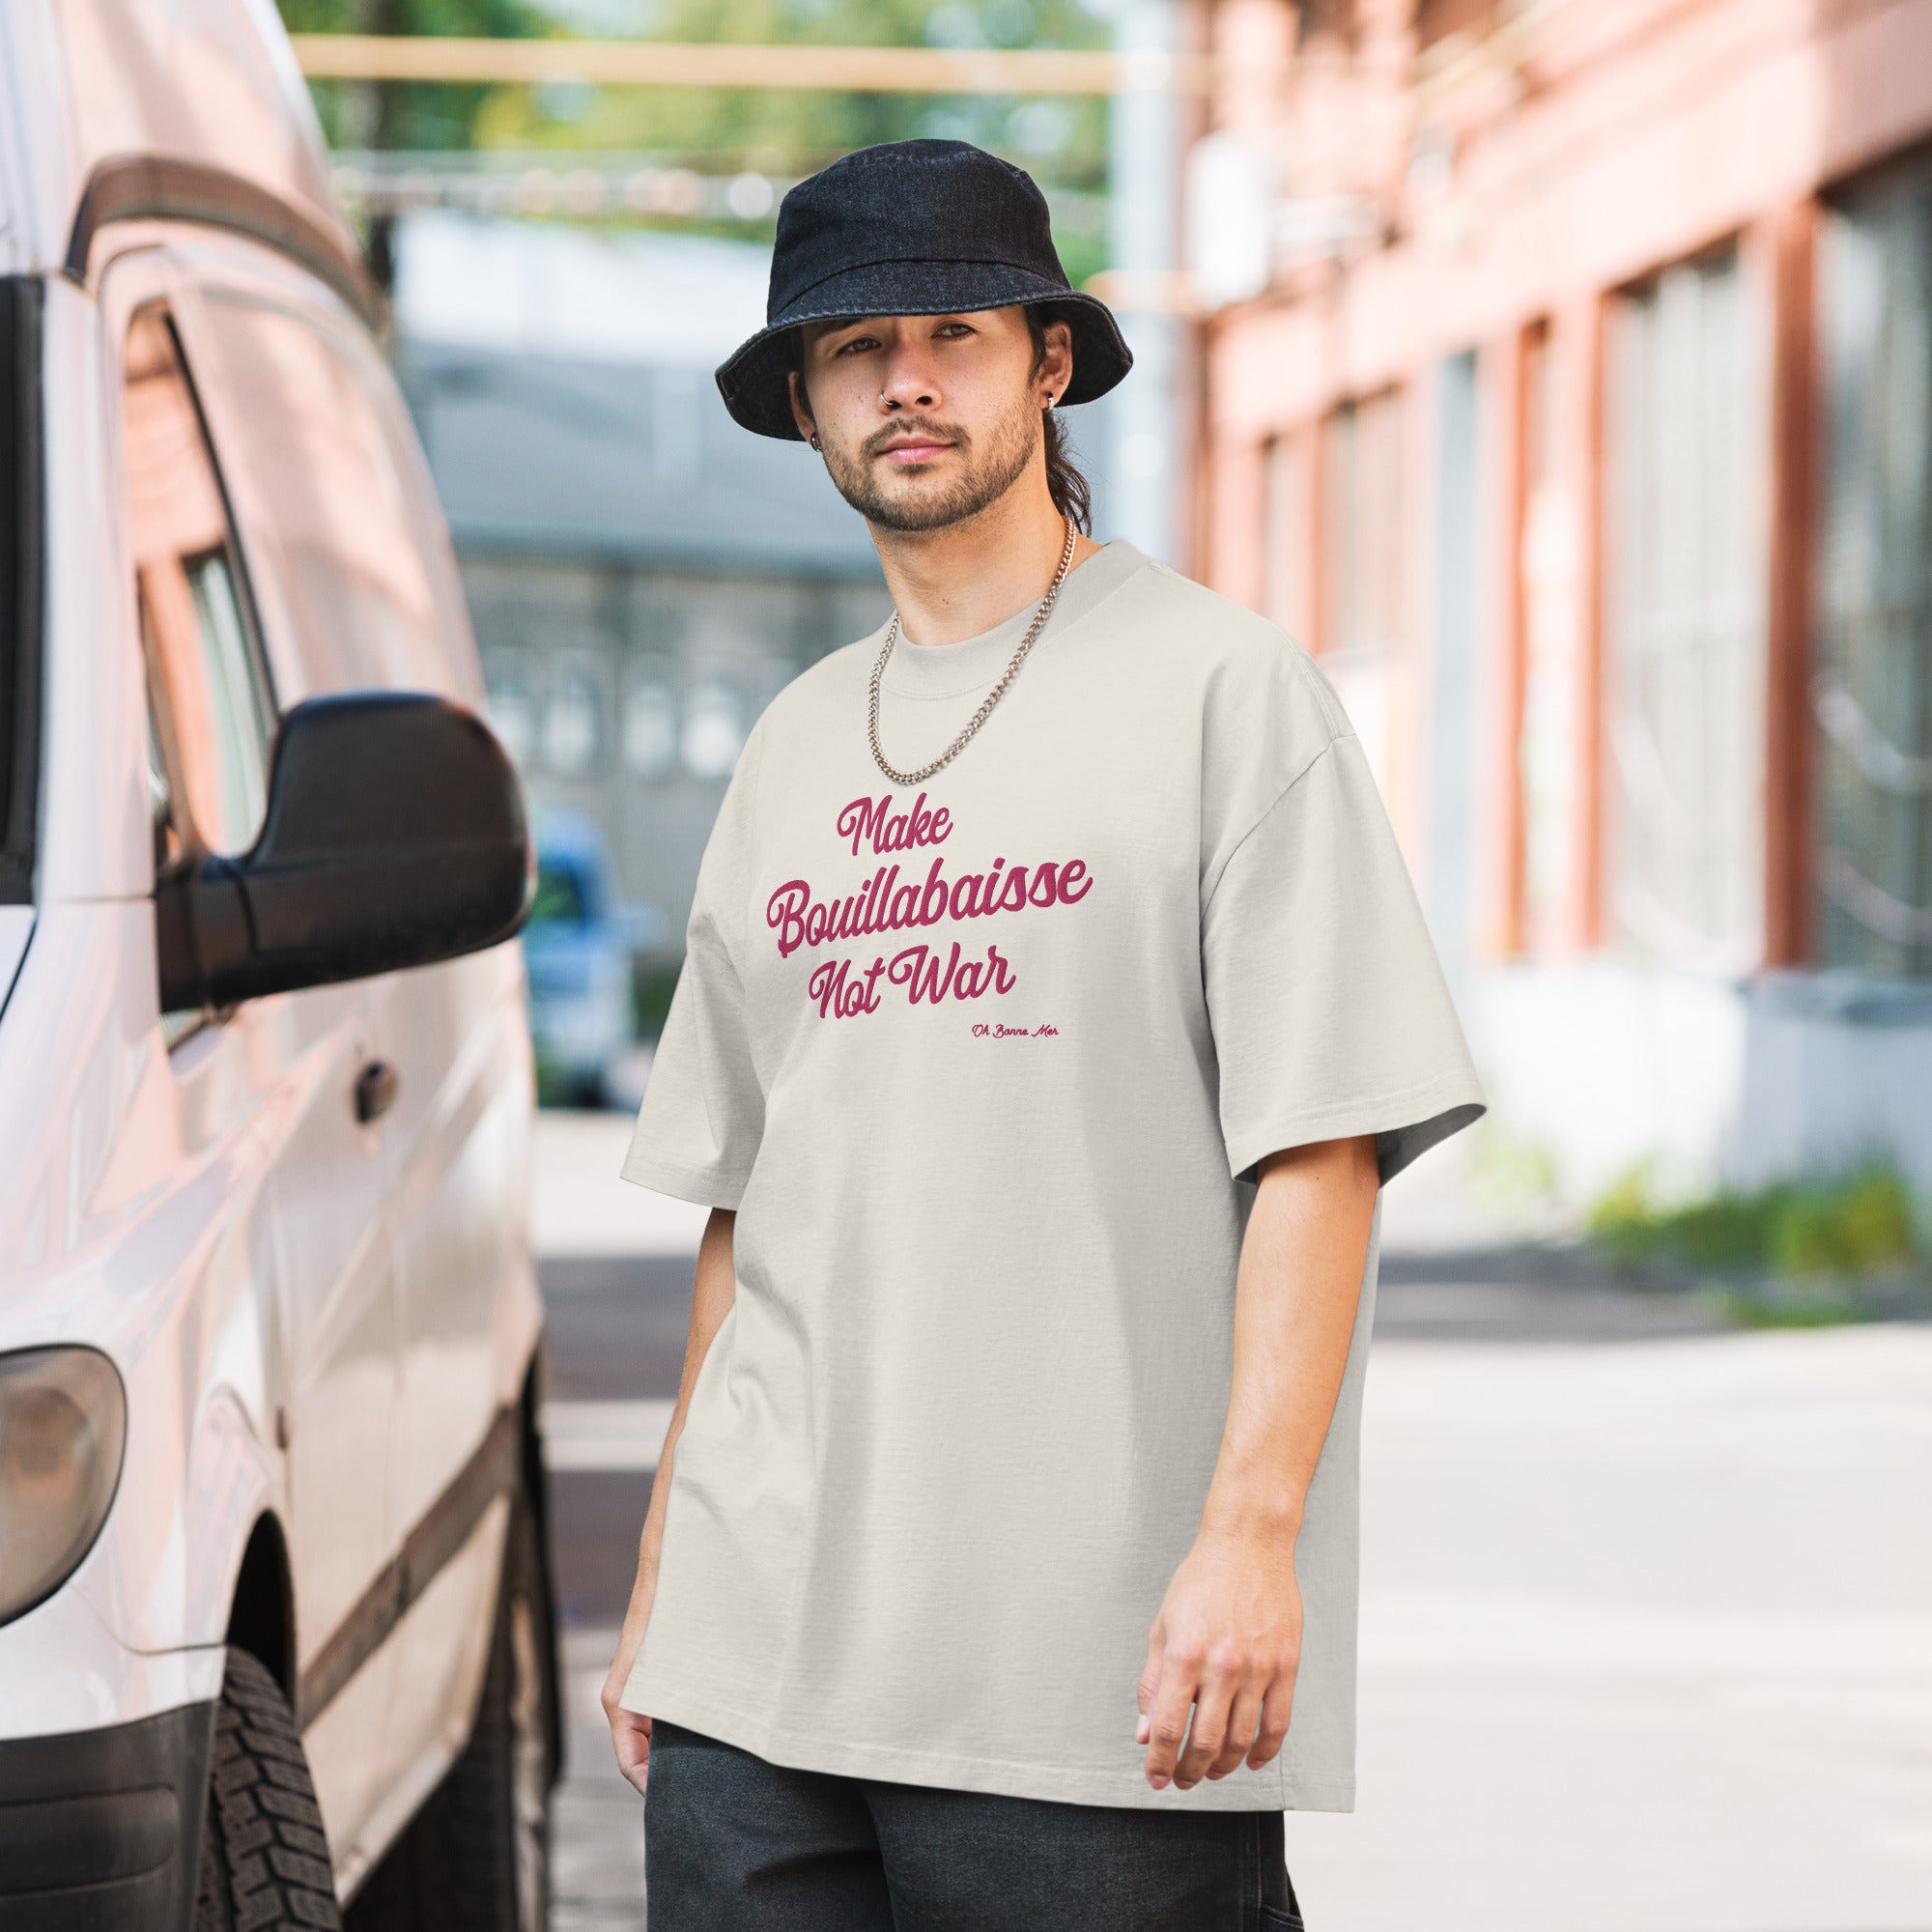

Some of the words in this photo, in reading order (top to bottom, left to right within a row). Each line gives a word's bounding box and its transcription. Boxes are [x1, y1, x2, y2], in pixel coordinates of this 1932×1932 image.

[836, 792, 953, 857] Make
[766, 857, 1094, 959] Bouillabaisse
[809, 957, 886, 1019] Not
[887, 942, 1016, 1005] War
[972, 1024, 990, 1037] Oh
